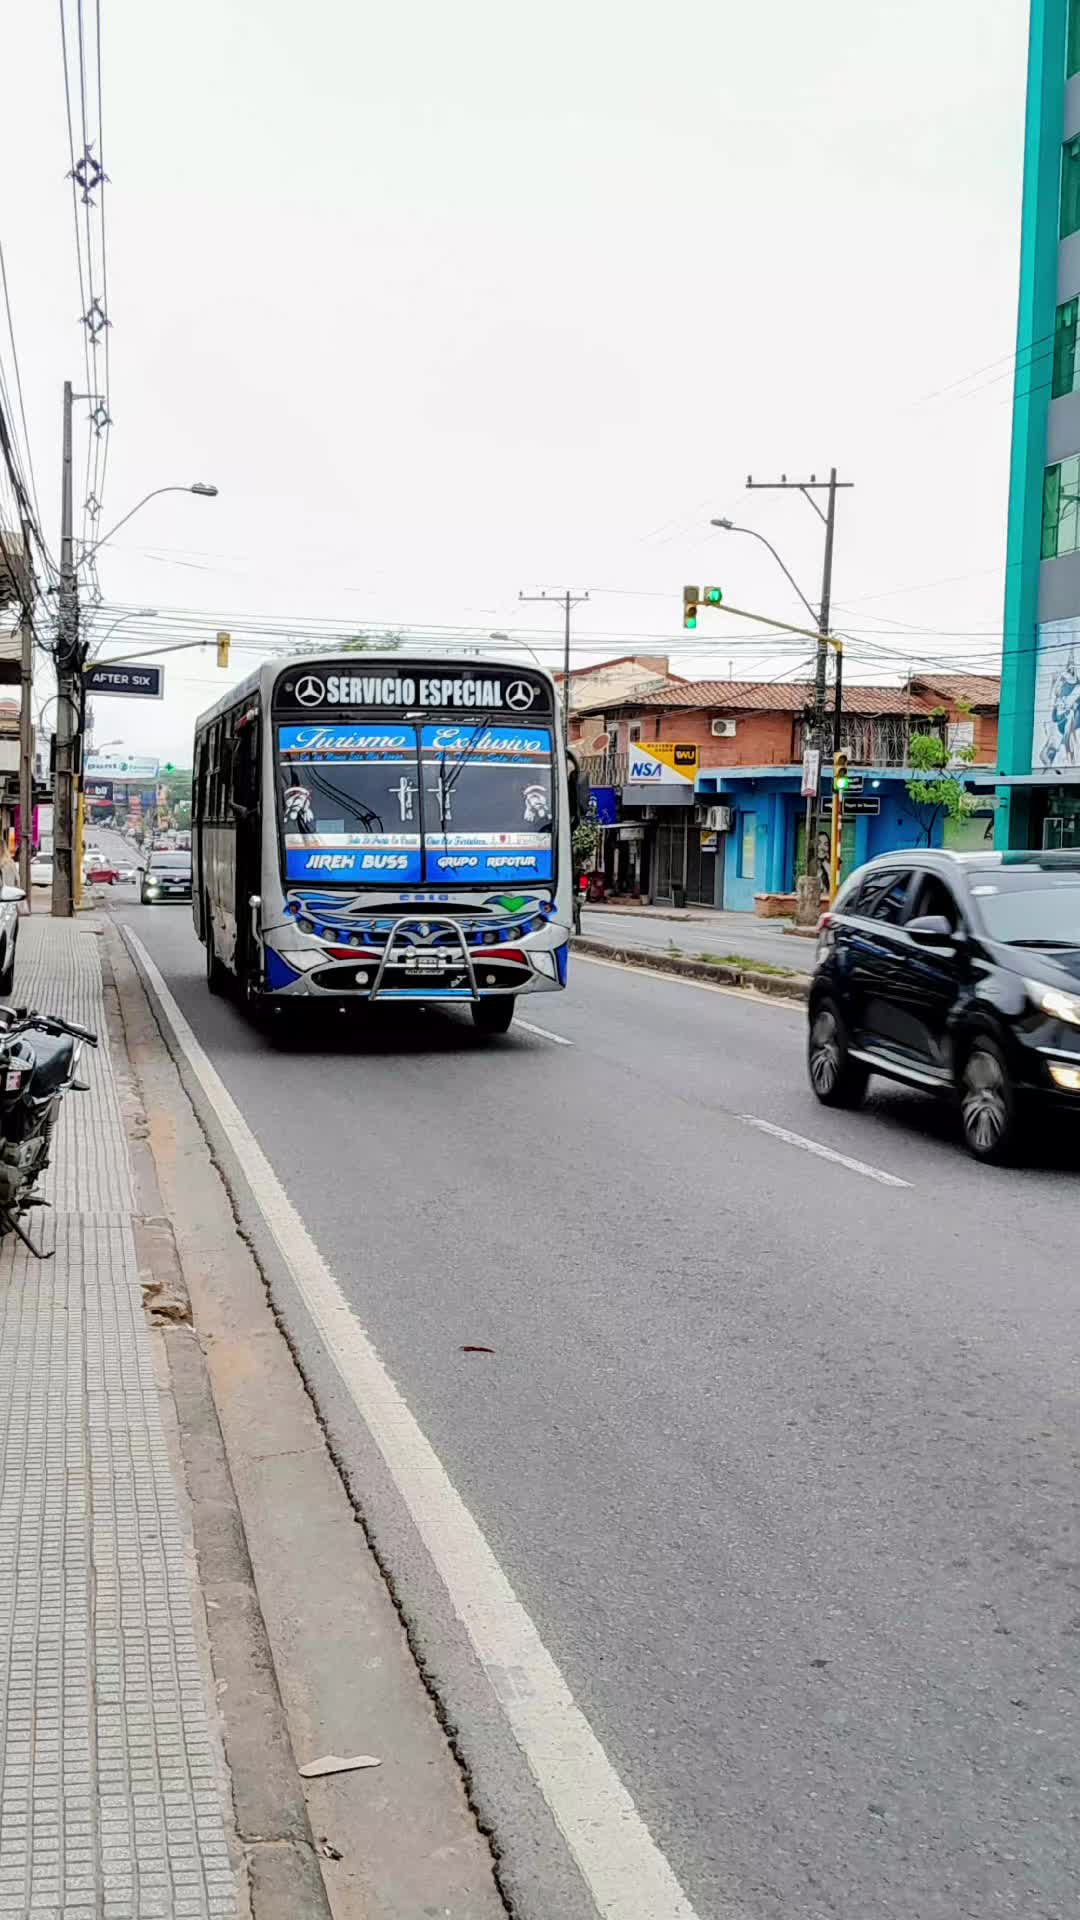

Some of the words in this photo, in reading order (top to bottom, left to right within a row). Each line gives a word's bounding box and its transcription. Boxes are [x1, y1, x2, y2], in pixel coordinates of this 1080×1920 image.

[92, 673, 129, 684] AFTER
[132, 676, 151, 686] SIX
[327, 676, 415, 704] SERVICIO
[419, 679, 503, 707] ESPECIAL
[290, 728, 406, 749] Turismo
[631, 762, 662, 777] NSA
[305, 855, 356, 870] JIREH
[361, 855, 408, 869] BUSS
[437, 856, 478, 869] GRUPO
